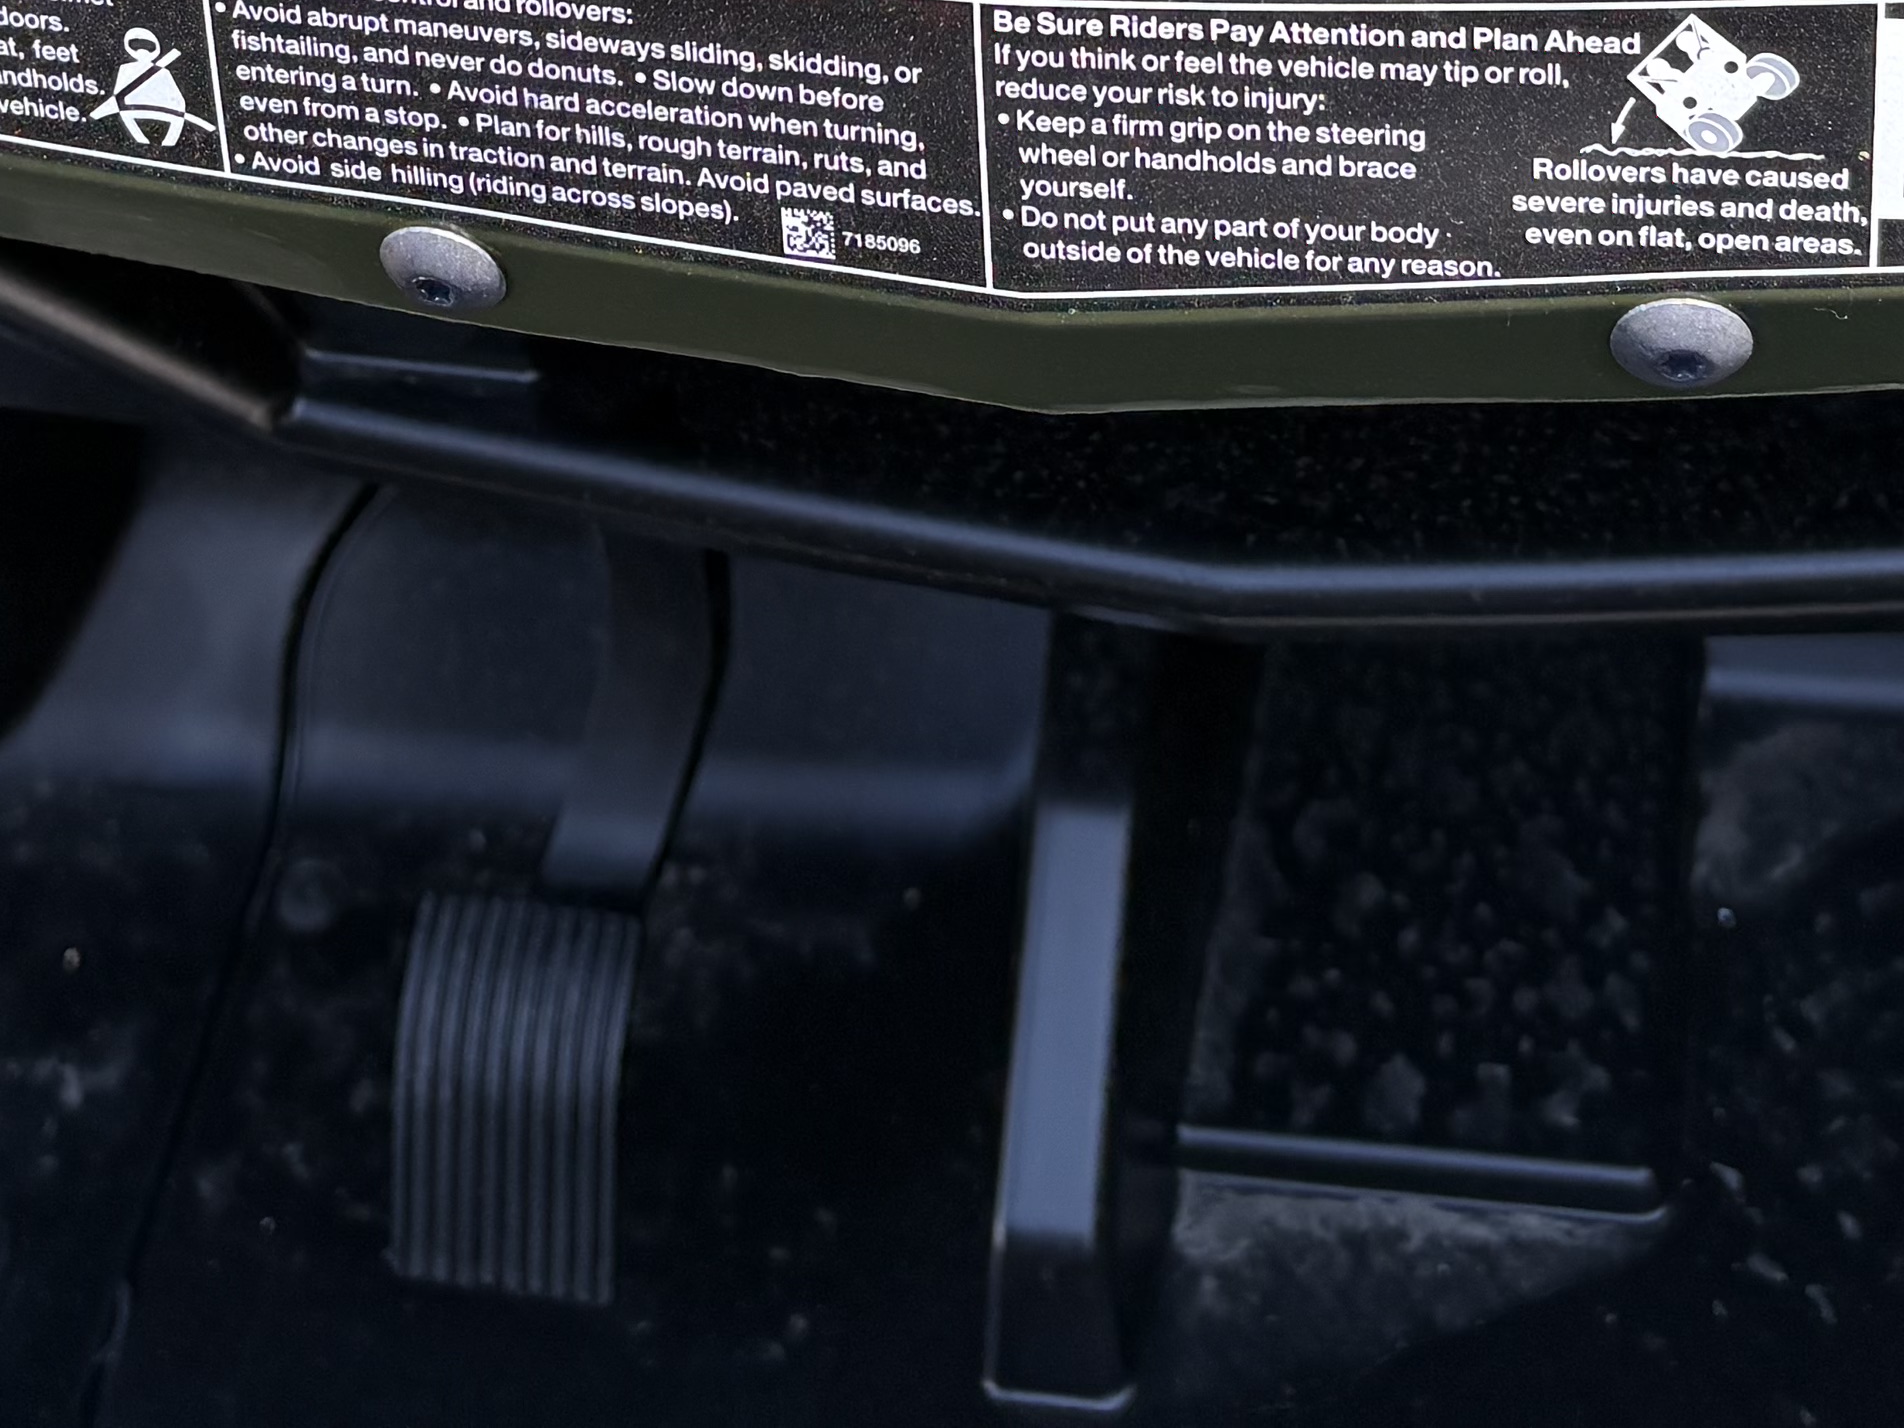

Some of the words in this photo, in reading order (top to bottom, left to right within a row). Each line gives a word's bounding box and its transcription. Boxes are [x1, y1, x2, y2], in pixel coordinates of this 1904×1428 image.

[994, 9, 1035, 34] Be
[1037, 11, 1104, 37] Sure
[1110, 14, 1204, 40] Riders
[1210, 18, 1264, 47] Pay
[1269, 21, 1405, 47] Attention
[1411, 26, 1466, 49] and
[1473, 27, 1538, 51] Plan
[1544, 29, 1641, 55] Ahead
[1533, 157, 1667, 184] Rollovers
[1672, 162, 1741, 186] have
[1745, 168, 1850, 191] caused
[1512, 194, 1606, 214] severe
[1612, 193, 1715, 219] injuries
[1720, 198, 1774, 222] and
[1779, 199, 1868, 227] death,
[842, 231, 921, 254] 7185096
[1525, 227, 1593, 245] even
[1598, 229, 1634, 247] on
[1638, 225, 1692, 251] flat,
[1698, 233, 1769, 254] open
[1774, 235, 1862, 256] areas.
